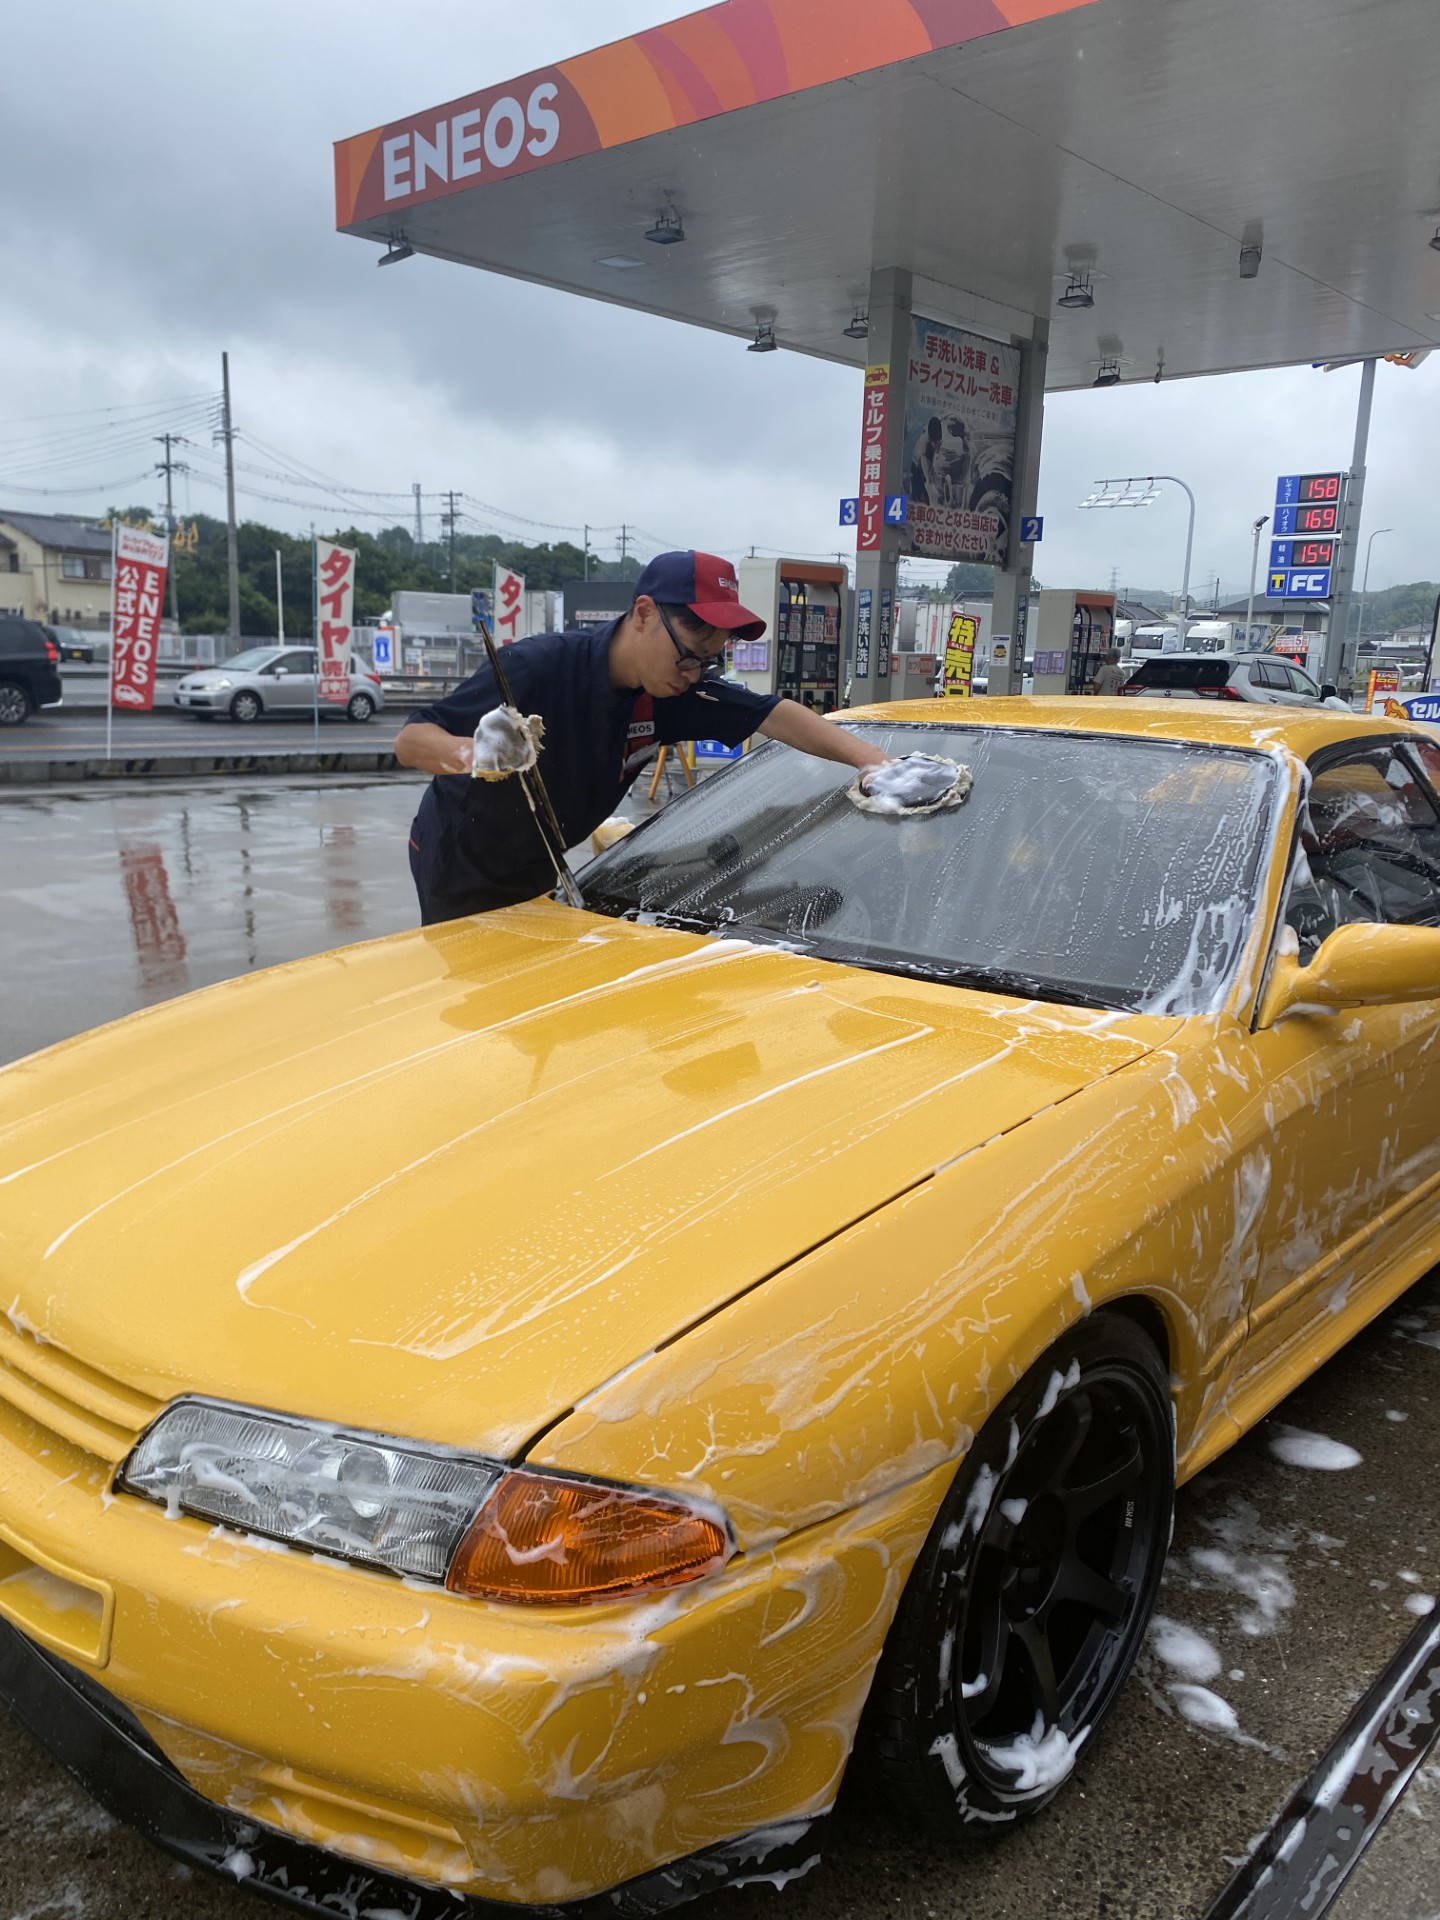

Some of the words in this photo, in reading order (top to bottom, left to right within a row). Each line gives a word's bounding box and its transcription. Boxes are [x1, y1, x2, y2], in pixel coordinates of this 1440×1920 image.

[383, 82, 560, 201] ENEOS
[926, 335, 987, 372] 手洗い洗車
[990, 356, 1000, 376] &
[909, 358, 1013, 407] ドライブスルー洗車
[861, 390, 885, 547] セルフ乗用車レーン
[1308, 477, 1339, 498] 158
[843, 500, 856, 524] 3
[888, 498, 902, 521] 4
[907, 503, 998, 533] 洗車のことなら当店に
[1281, 508, 1290, 532] ハイオク
[1305, 508, 1335, 529] 169
[915, 527, 988, 551] おまかせください
[1026, 519, 1040, 541] 2
[1301, 543, 1331, 564] 154
[1291, 574, 1326, 592] FC
[320, 548, 352, 659] タイヤ
[497, 574, 522, 646] タイ
[113, 564, 140, 681] 公式アプリ
[131, 569, 160, 685] ENEOS
[856, 607, 870, 676] 手洗い洗車
[879, 607, 890, 675] 手洗い洗車
[1411, 701, 1440, 719] セル
